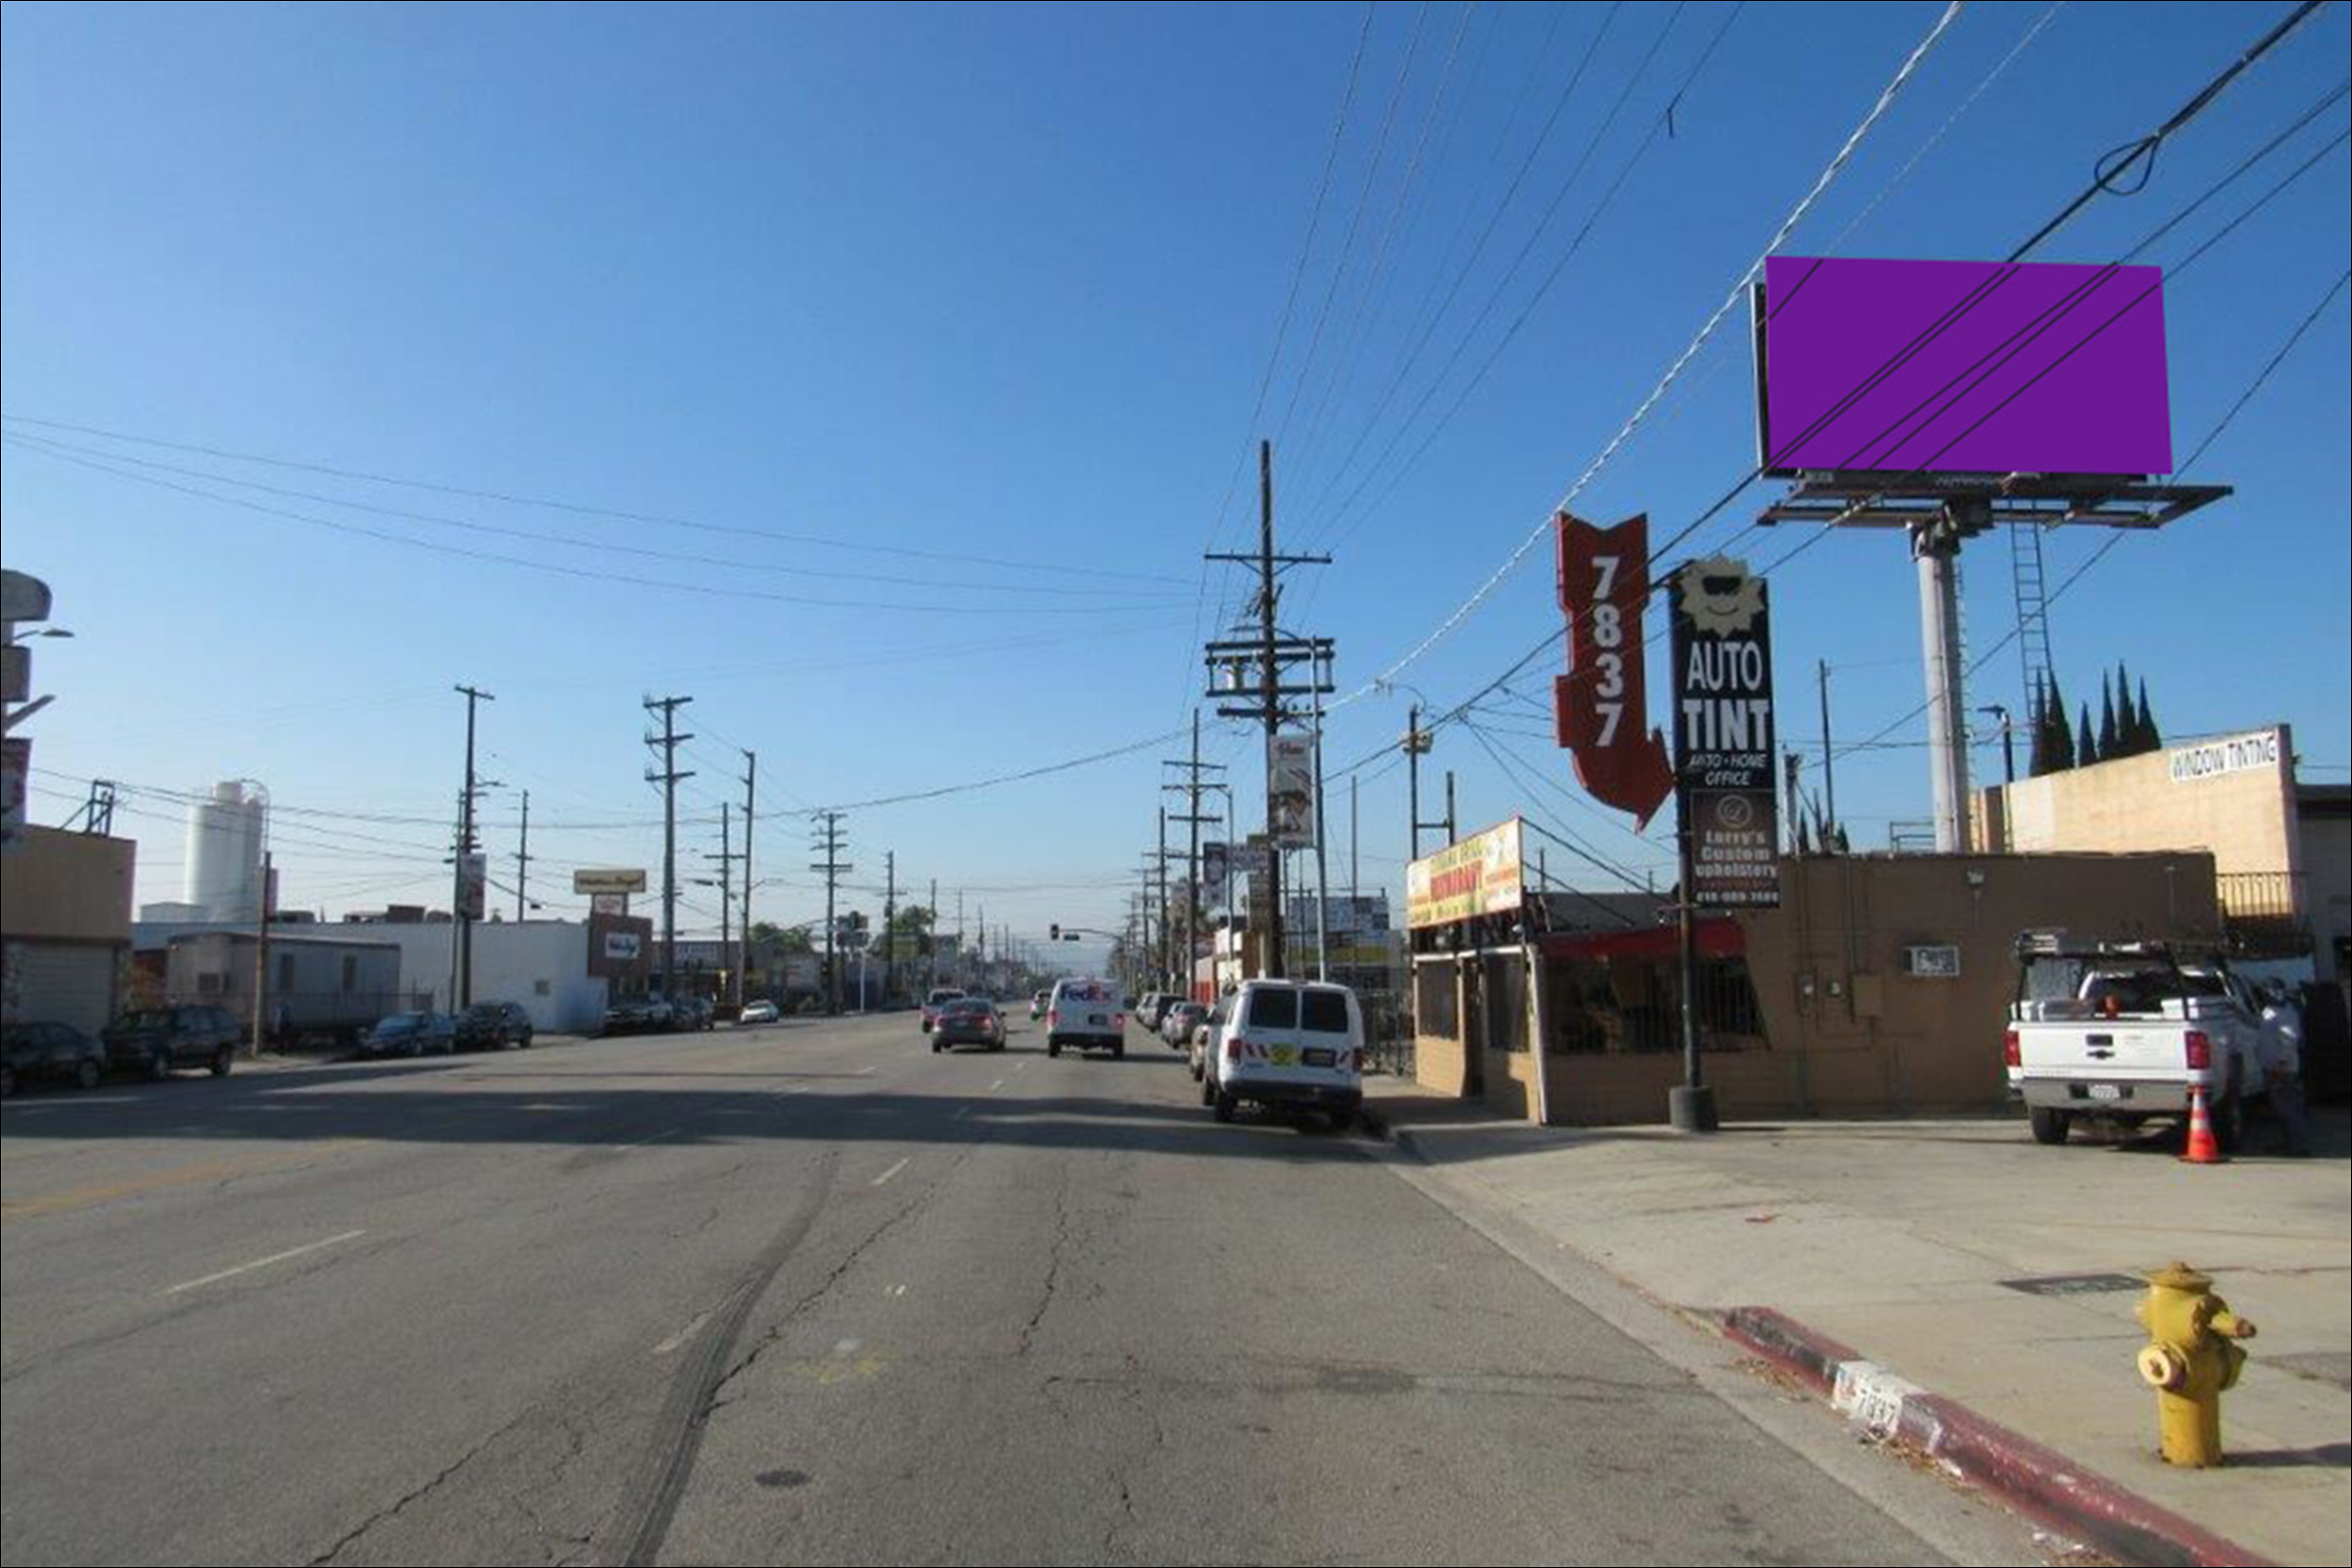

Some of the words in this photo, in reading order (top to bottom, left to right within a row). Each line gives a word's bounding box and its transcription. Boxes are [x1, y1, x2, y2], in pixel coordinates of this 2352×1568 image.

[1592, 557, 1623, 747] 7837
[1687, 641, 1762, 691] AUTO
[1683, 699, 1769, 751] TINT
[1705, 769, 1750, 785] OFFICE
[2174, 747, 2225, 777] WINDOW
[2228, 735, 2276, 768] TINTING
[1060, 984, 1113, 1003] FedEx
